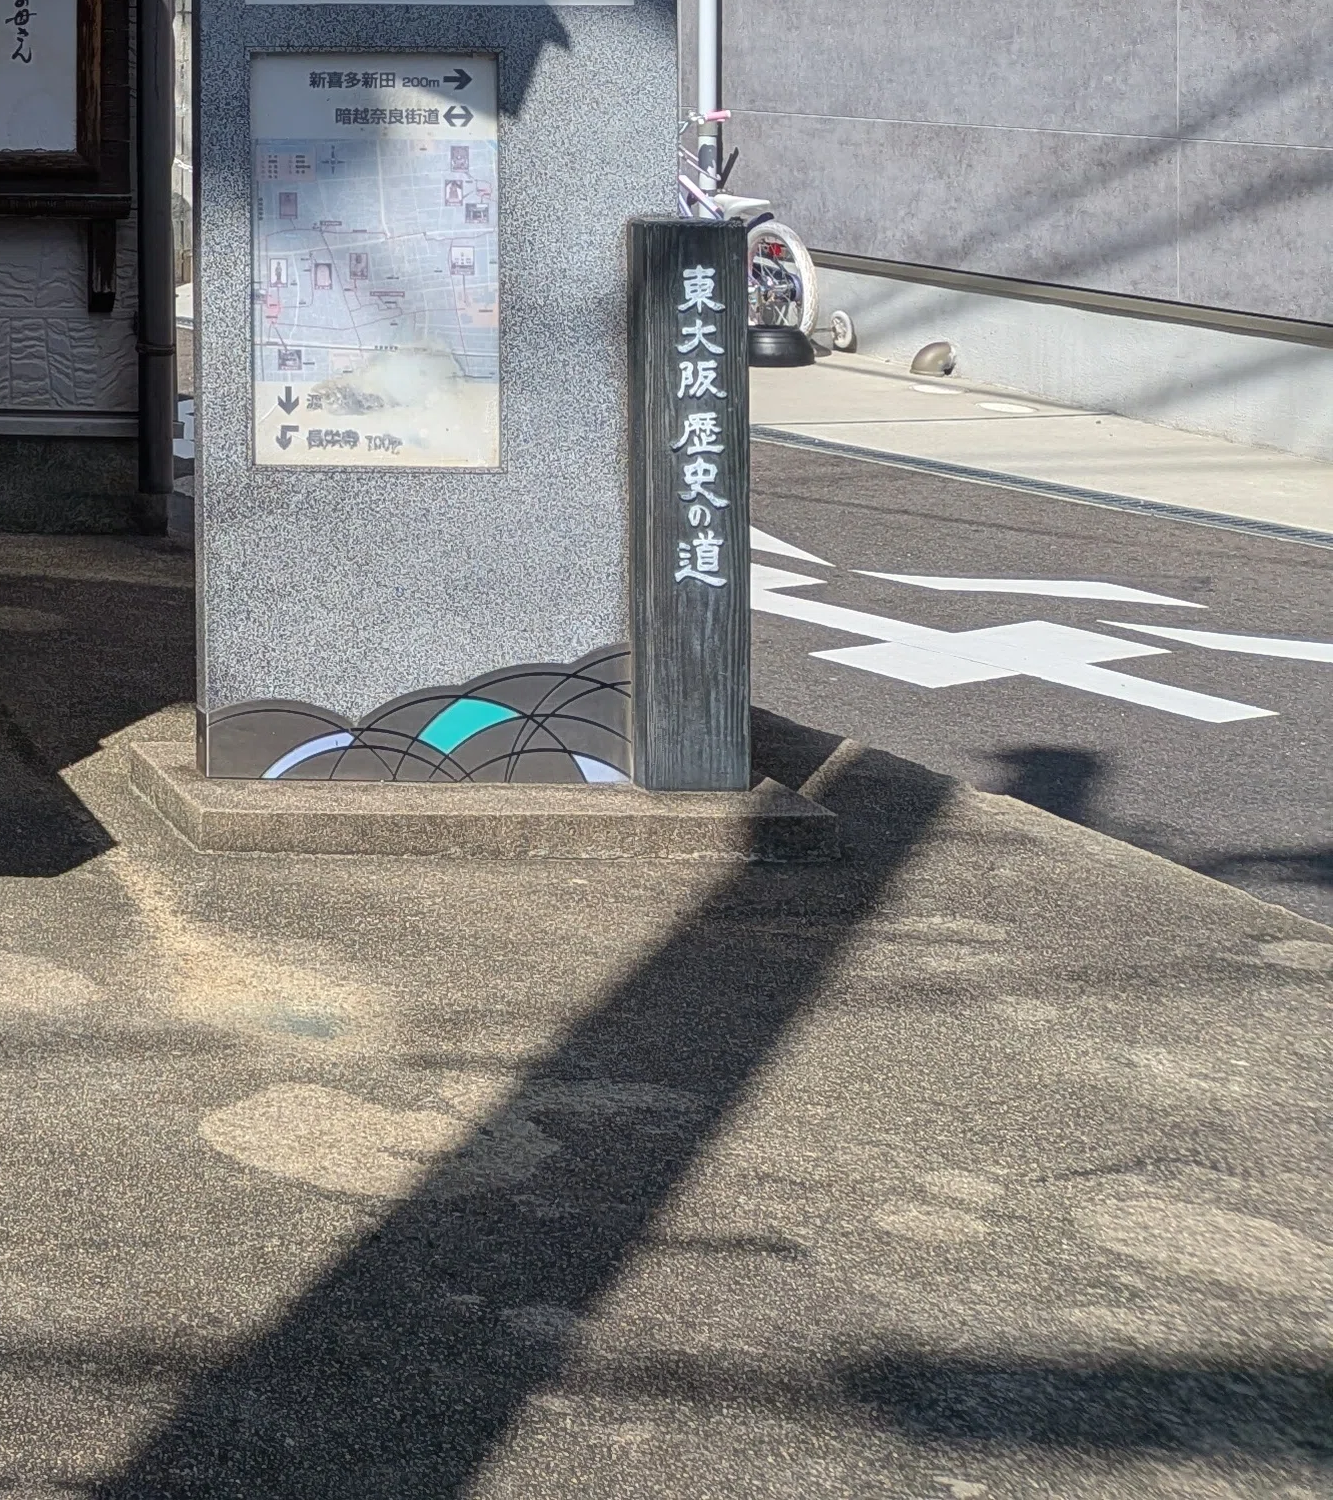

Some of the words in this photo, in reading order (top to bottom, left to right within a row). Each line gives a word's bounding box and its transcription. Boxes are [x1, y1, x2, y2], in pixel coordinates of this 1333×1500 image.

[309, 71, 396, 90] 新喜多新田
[402, 76, 440, 89] 200m
[334, 107, 440, 126] 暗越奈良街道
[671, 264, 730, 587] 東大阪歴史の道
